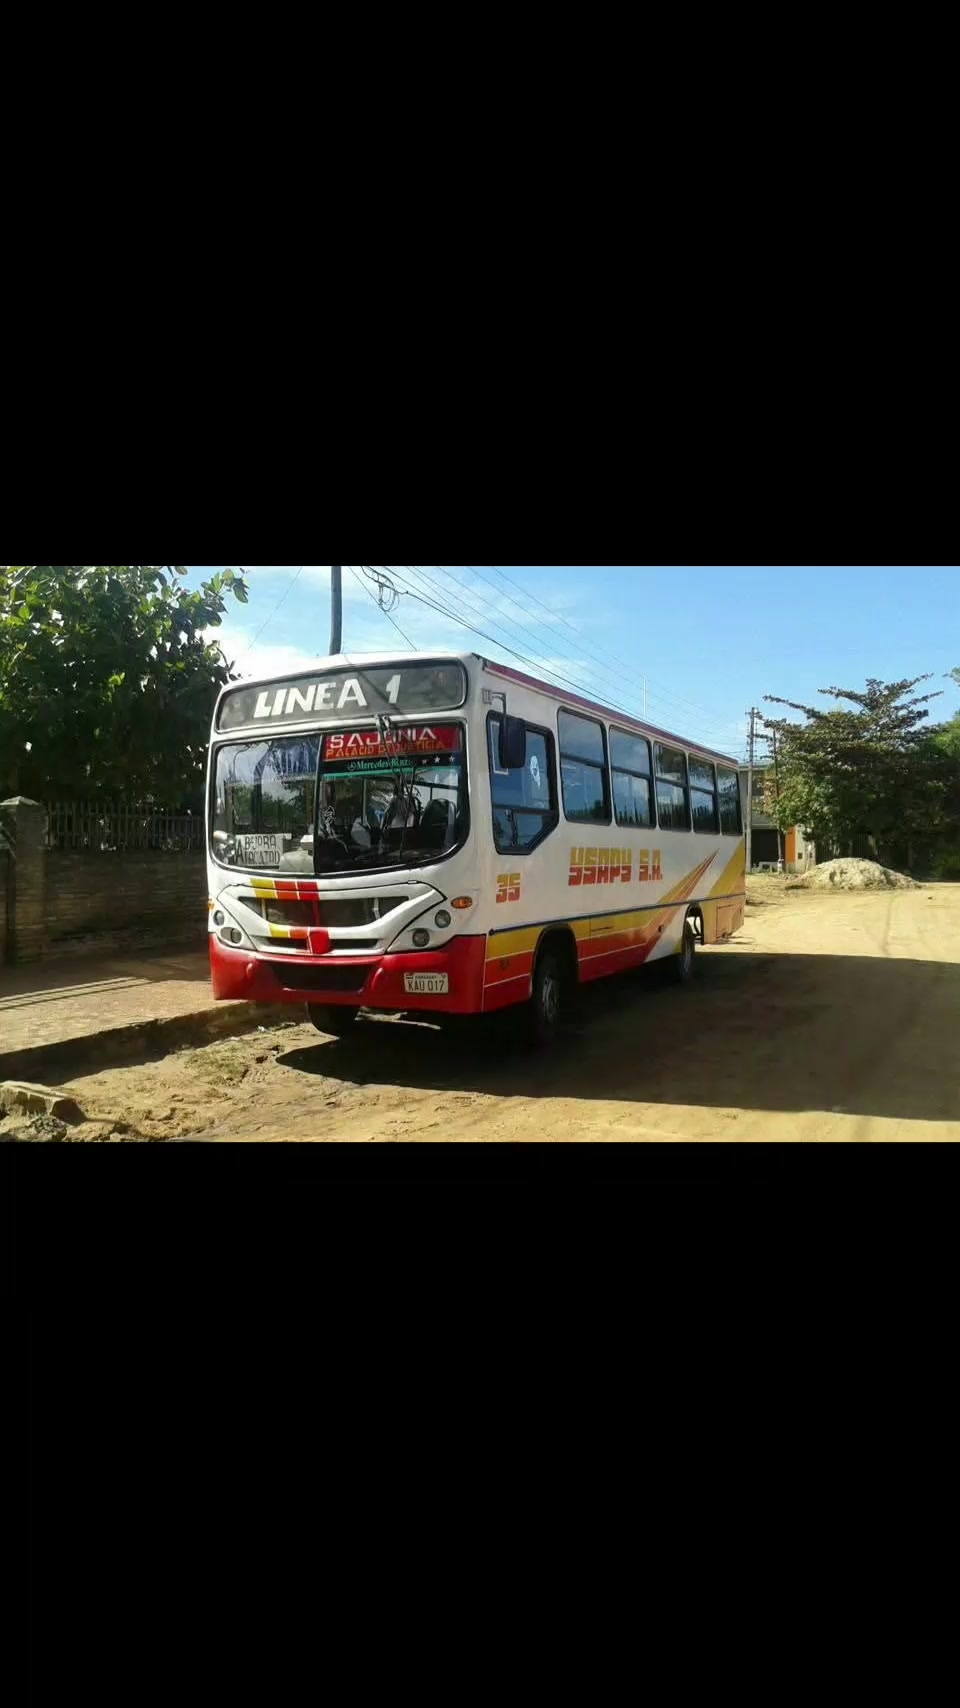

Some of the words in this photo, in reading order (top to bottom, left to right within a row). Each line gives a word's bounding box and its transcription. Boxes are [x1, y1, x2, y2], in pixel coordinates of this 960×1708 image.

[253, 678, 368, 719] LINEA
[385, 674, 401, 704] 1
[568, 847, 632, 886] YSAPY
[639, 848, 663, 882] S.A.
[496, 872, 521, 904] 35
[407, 980, 425, 991] KAU
[427, 980, 445, 992] 017
